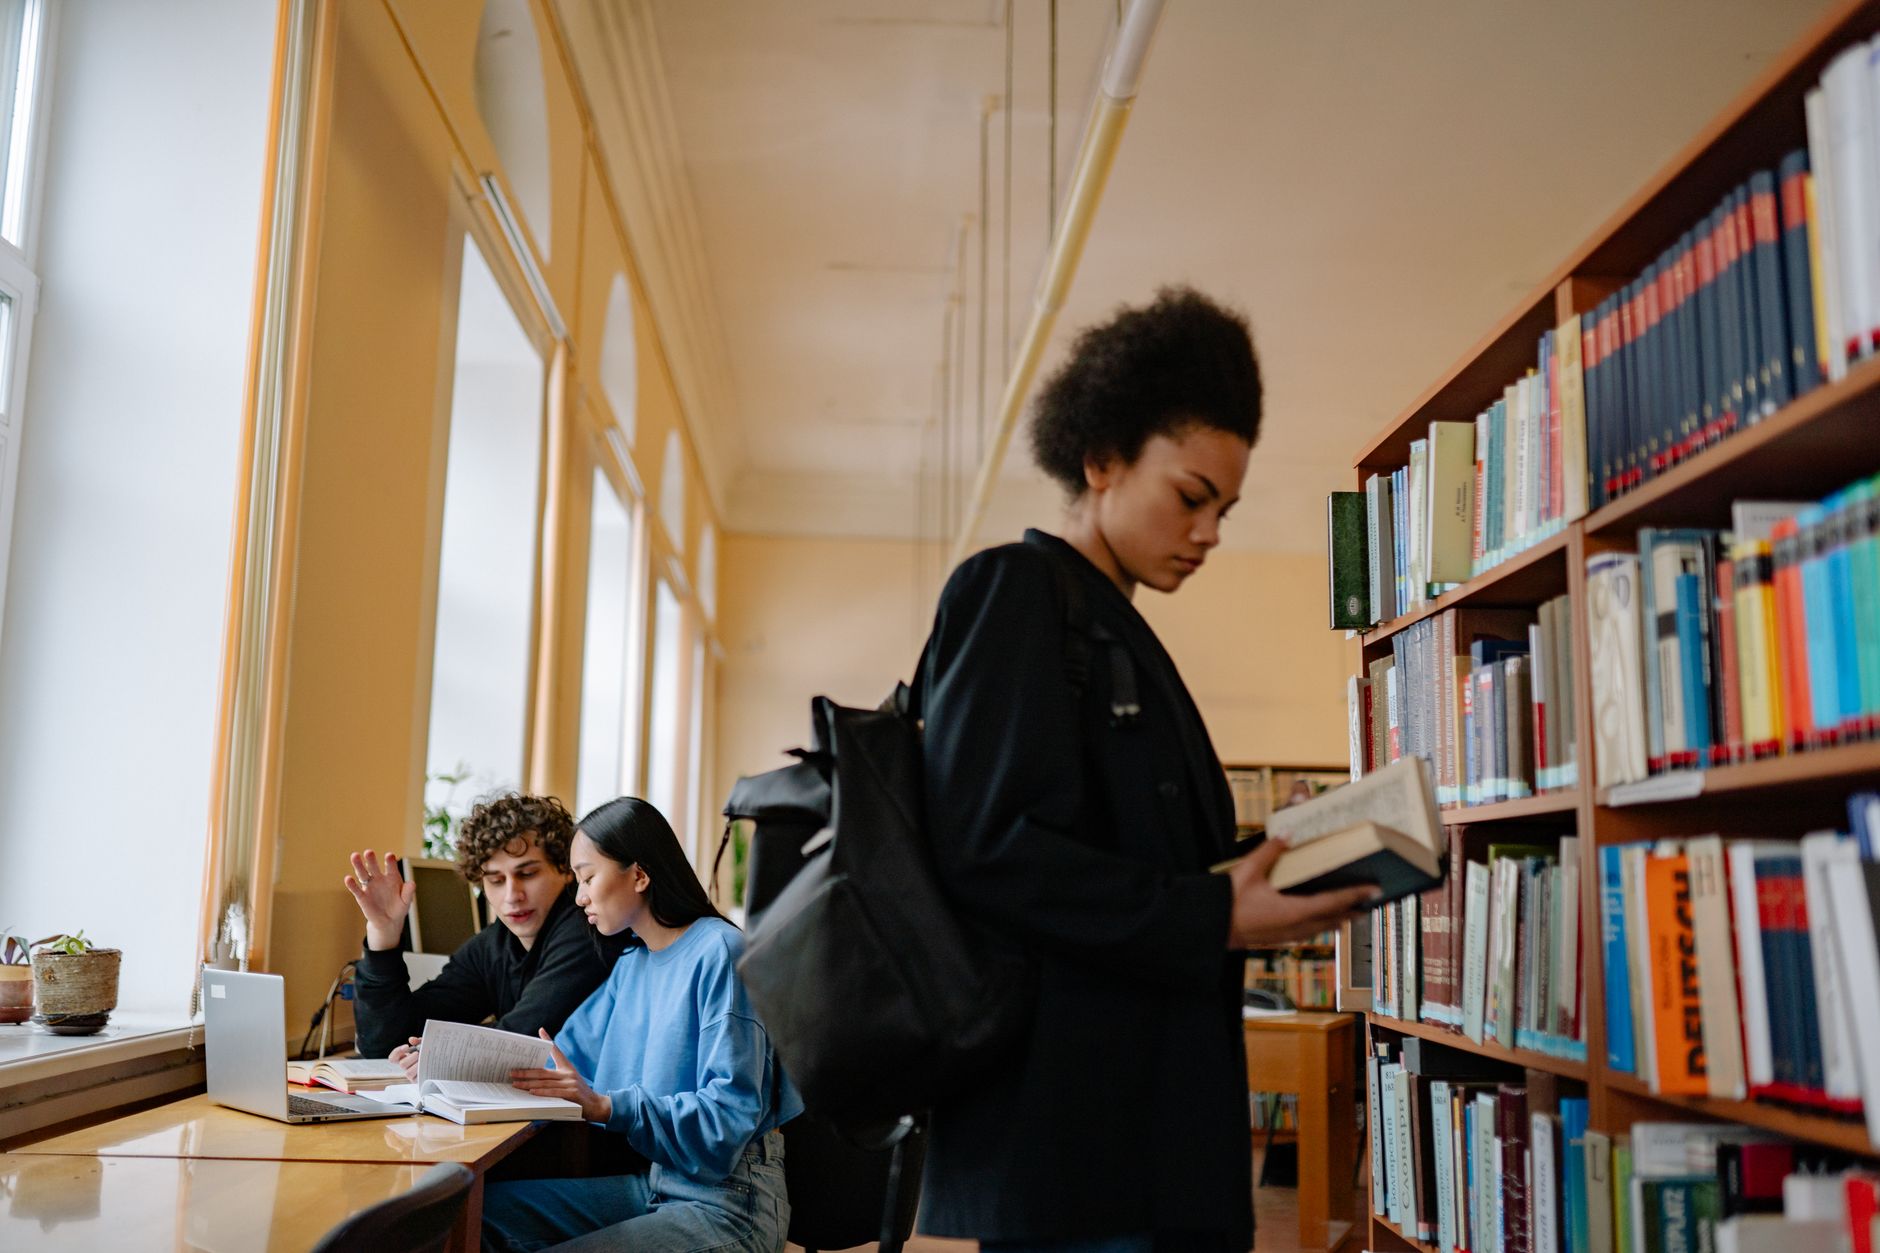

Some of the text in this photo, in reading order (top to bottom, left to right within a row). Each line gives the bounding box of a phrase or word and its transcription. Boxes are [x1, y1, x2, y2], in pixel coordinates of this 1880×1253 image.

[1372, 1083, 1380, 1187] Словари
[1387, 1118, 1396, 1207] Болгарский
[1400, 1098, 1410, 1210] Словари
[1482, 1129, 1492, 1253] Словари
